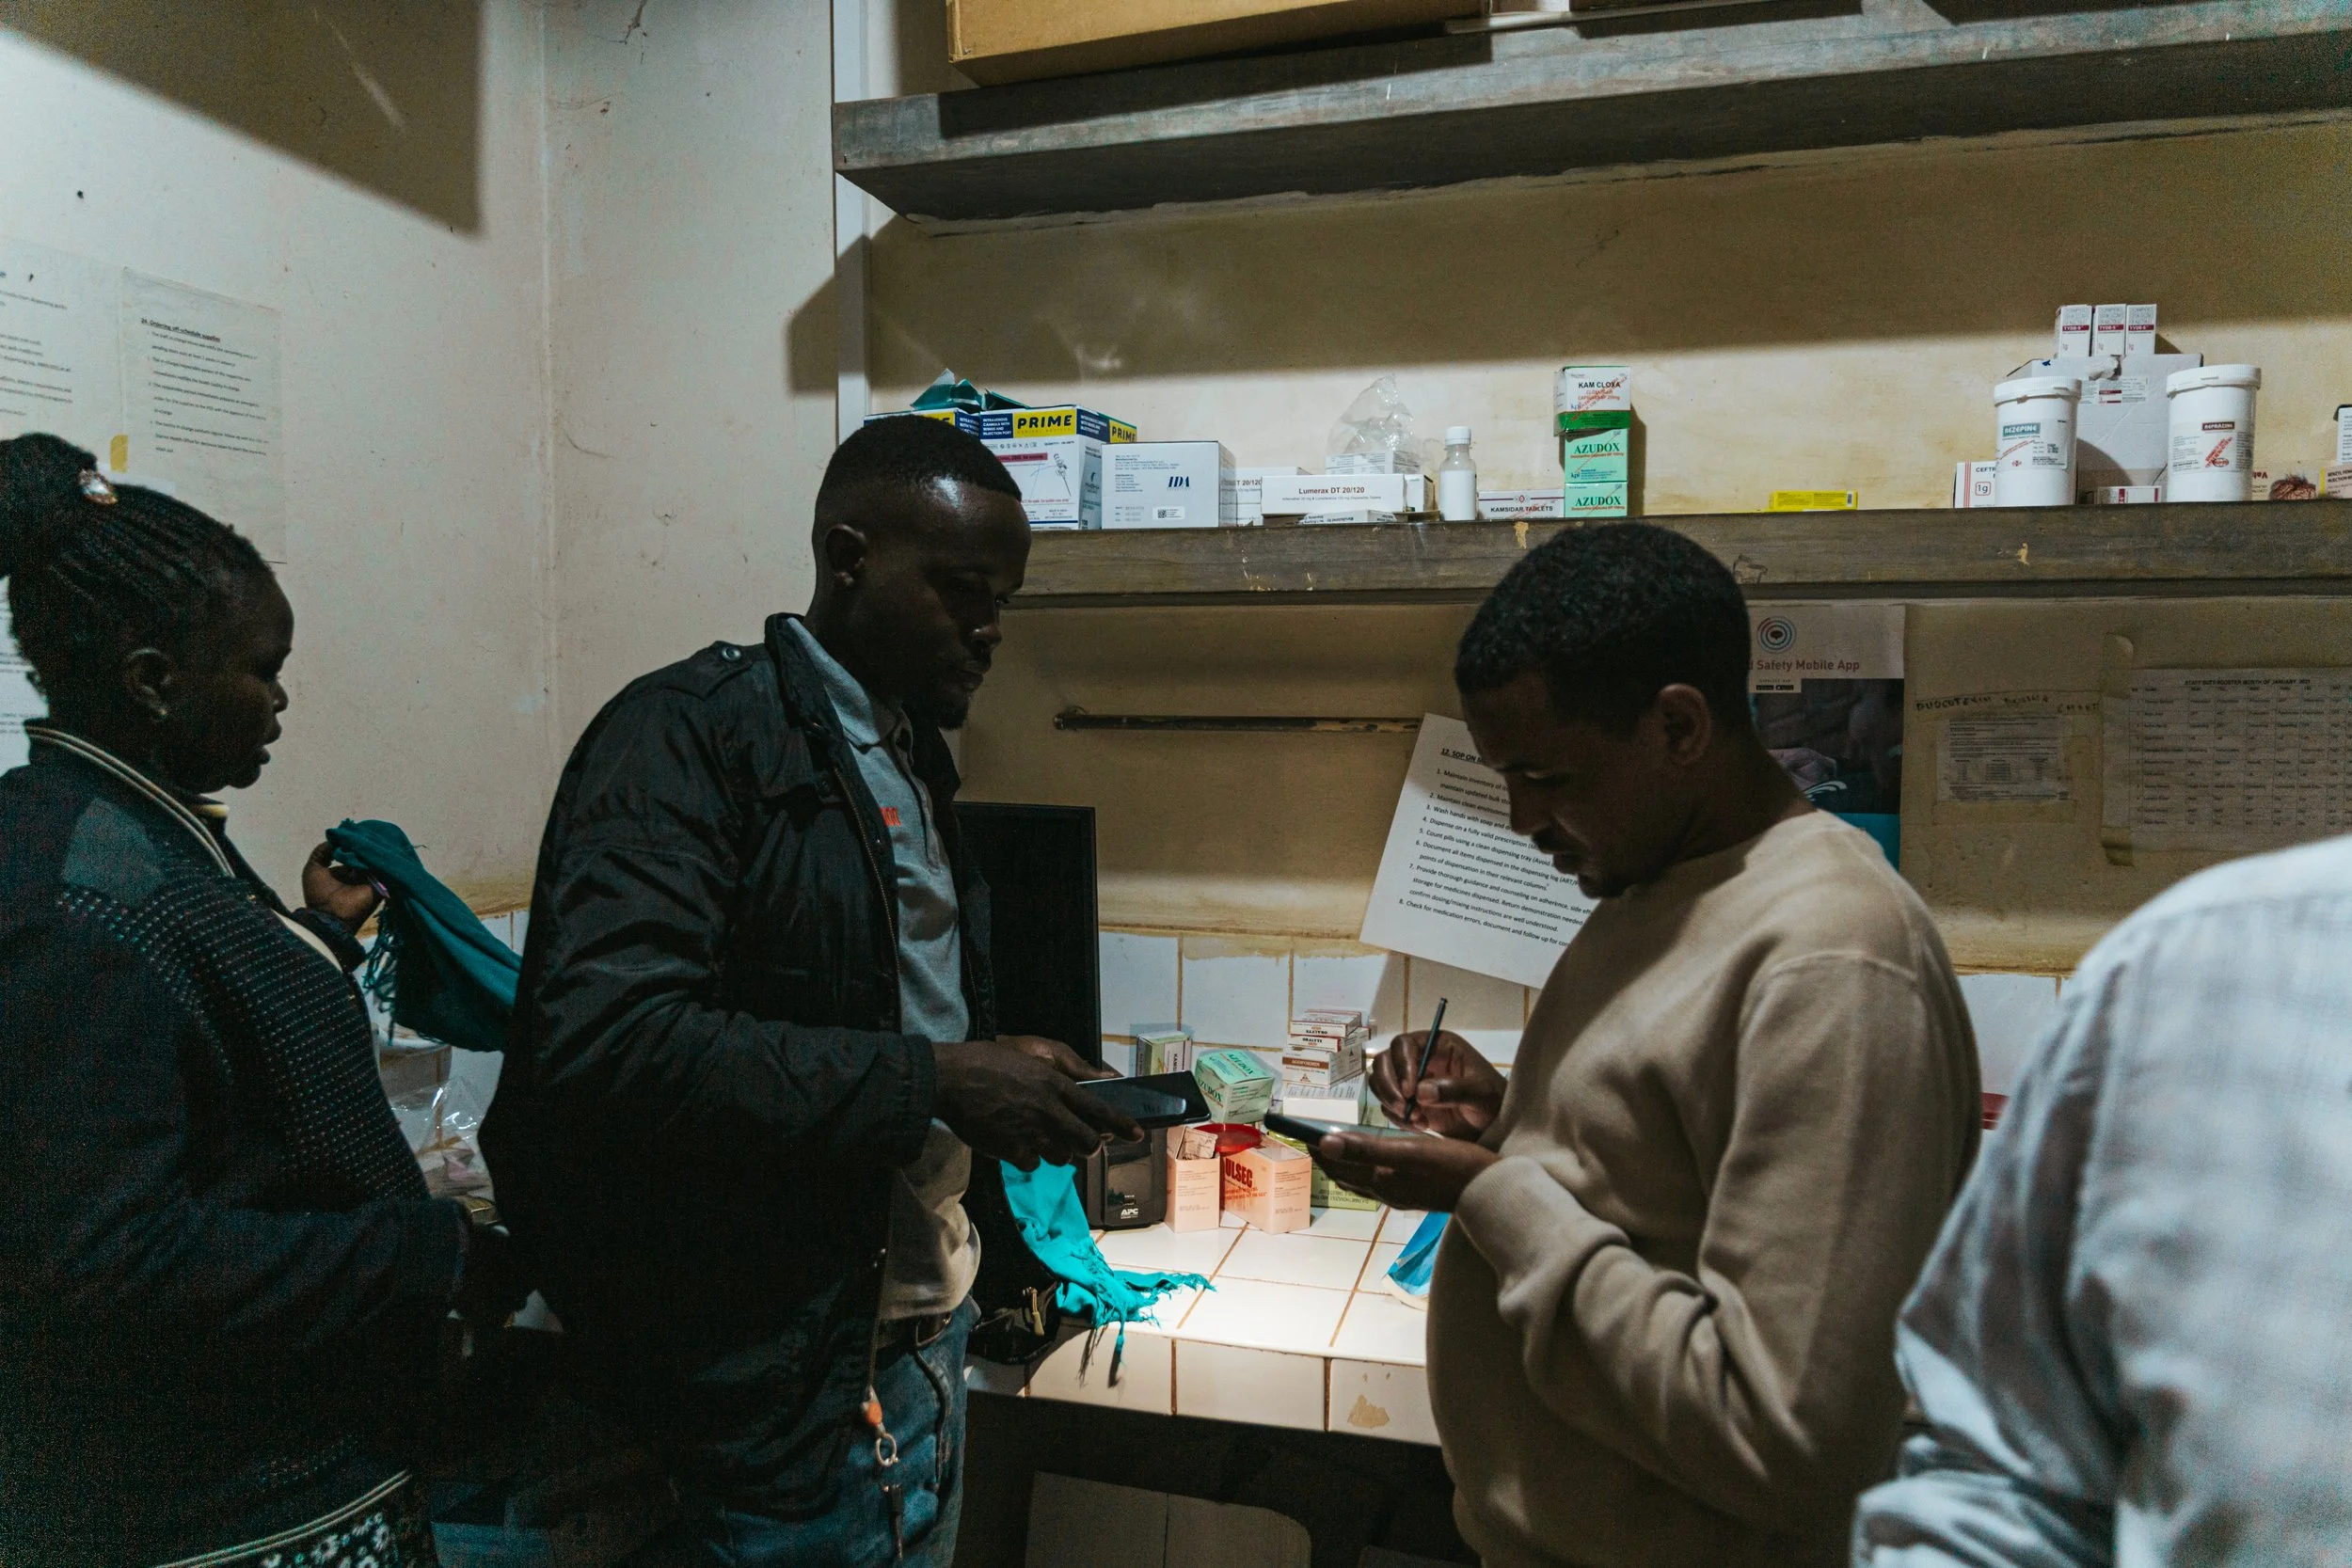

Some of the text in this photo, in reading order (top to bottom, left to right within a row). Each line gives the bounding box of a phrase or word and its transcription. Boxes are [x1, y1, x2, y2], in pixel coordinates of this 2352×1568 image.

[1017, 415, 1073, 430] PRIME
[1112, 426, 1136, 443] PRIME
[1574, 442, 1620, 454] AZUDOX
[1168, 476, 1190, 487] IDA
[1978, 484, 1989, 494] 1g
[1575, 496, 1621, 507] AZUDOX
[1756, 659, 1861, 673] Safety Mobile App
[1440, 748, 1450, 757] 12.
[1453, 751, 1465, 760] SOP
[1466, 754, 1476, 763] ON
[1443, 770, 1468, 781] Maintain
[1469, 777, 1494, 788] inventory
[1437, 794, 1461, 805] Maintain
[1461, 800, 1477, 809] clean
[1439, 783, 1500, 802] maintain updated bulk
[1433, 806, 1449, 816] Wash
[1449, 809, 1466, 820] hands
[1467, 814, 1480, 822] with
[1480, 817, 1493, 827] soap
[1429, 817, 1454, 829] Dispense
[1468, 827, 1481, 836] fully
[1480, 831, 1494, 839] valid
[1494, 833, 1528, 848] prescription
[1426, 829, 1443, 839] Count
[1455, 837, 1470, 847] using
[1475, 843, 1491, 851] clean
[1490, 847, 1520, 860] dispensing
[1520, 853, 1534, 863] tray
[1532, 856, 1551, 866] (Avoid
[1422, 841, 1452, 854] Document
[1459, 851, 1475, 860] items
[1475, 855, 1503, 867] dispensed
[1520, 867, 1550, 880] dispensing
[1549, 874, 1560, 882] log
[1419, 854, 1437, 863] points
[1444, 860, 1479, 874] dispensation
[1486, 870, 1500, 879] their
[1500, 874, 1523, 884] relevant
[1523, 880, 1548, 891] columns.
[1416, 864, 1438, 876] Provide
[1438, 870, 1464, 882] thorough
[1463, 878, 1489, 889] guidance
[1500, 887, 1530, 900] counseling
[1538, 896, 1569, 911] adherence,
[1412, 878, 1434, 887] storage
[1443, 885, 1471, 897] medicines
[1471, 892, 1501, 904] dispensed.
[1501, 899, 1520, 910] Return
[1520, 905, 1562, 920] demonstration
[1406, 900, 1423, 910] Check
[1432, 907, 1464, 920] medication
[1464, 915, 1482, 926] errors,
[1482, 920, 1511, 933] document
[1523, 930, 1541, 940] follow
[1409, 889, 1431, 899] confirm
[1431, 895, 1470, 911] dosing/mixing
[1470, 904, 1502, 918] instructions
[1525, 919, 1559, 932] understood.
[1227, 1053, 1254, 1075] AZUDOX
[1225, 1157, 1253, 1189] ULSEC
[1120, 1208, 1139, 1216] APC
